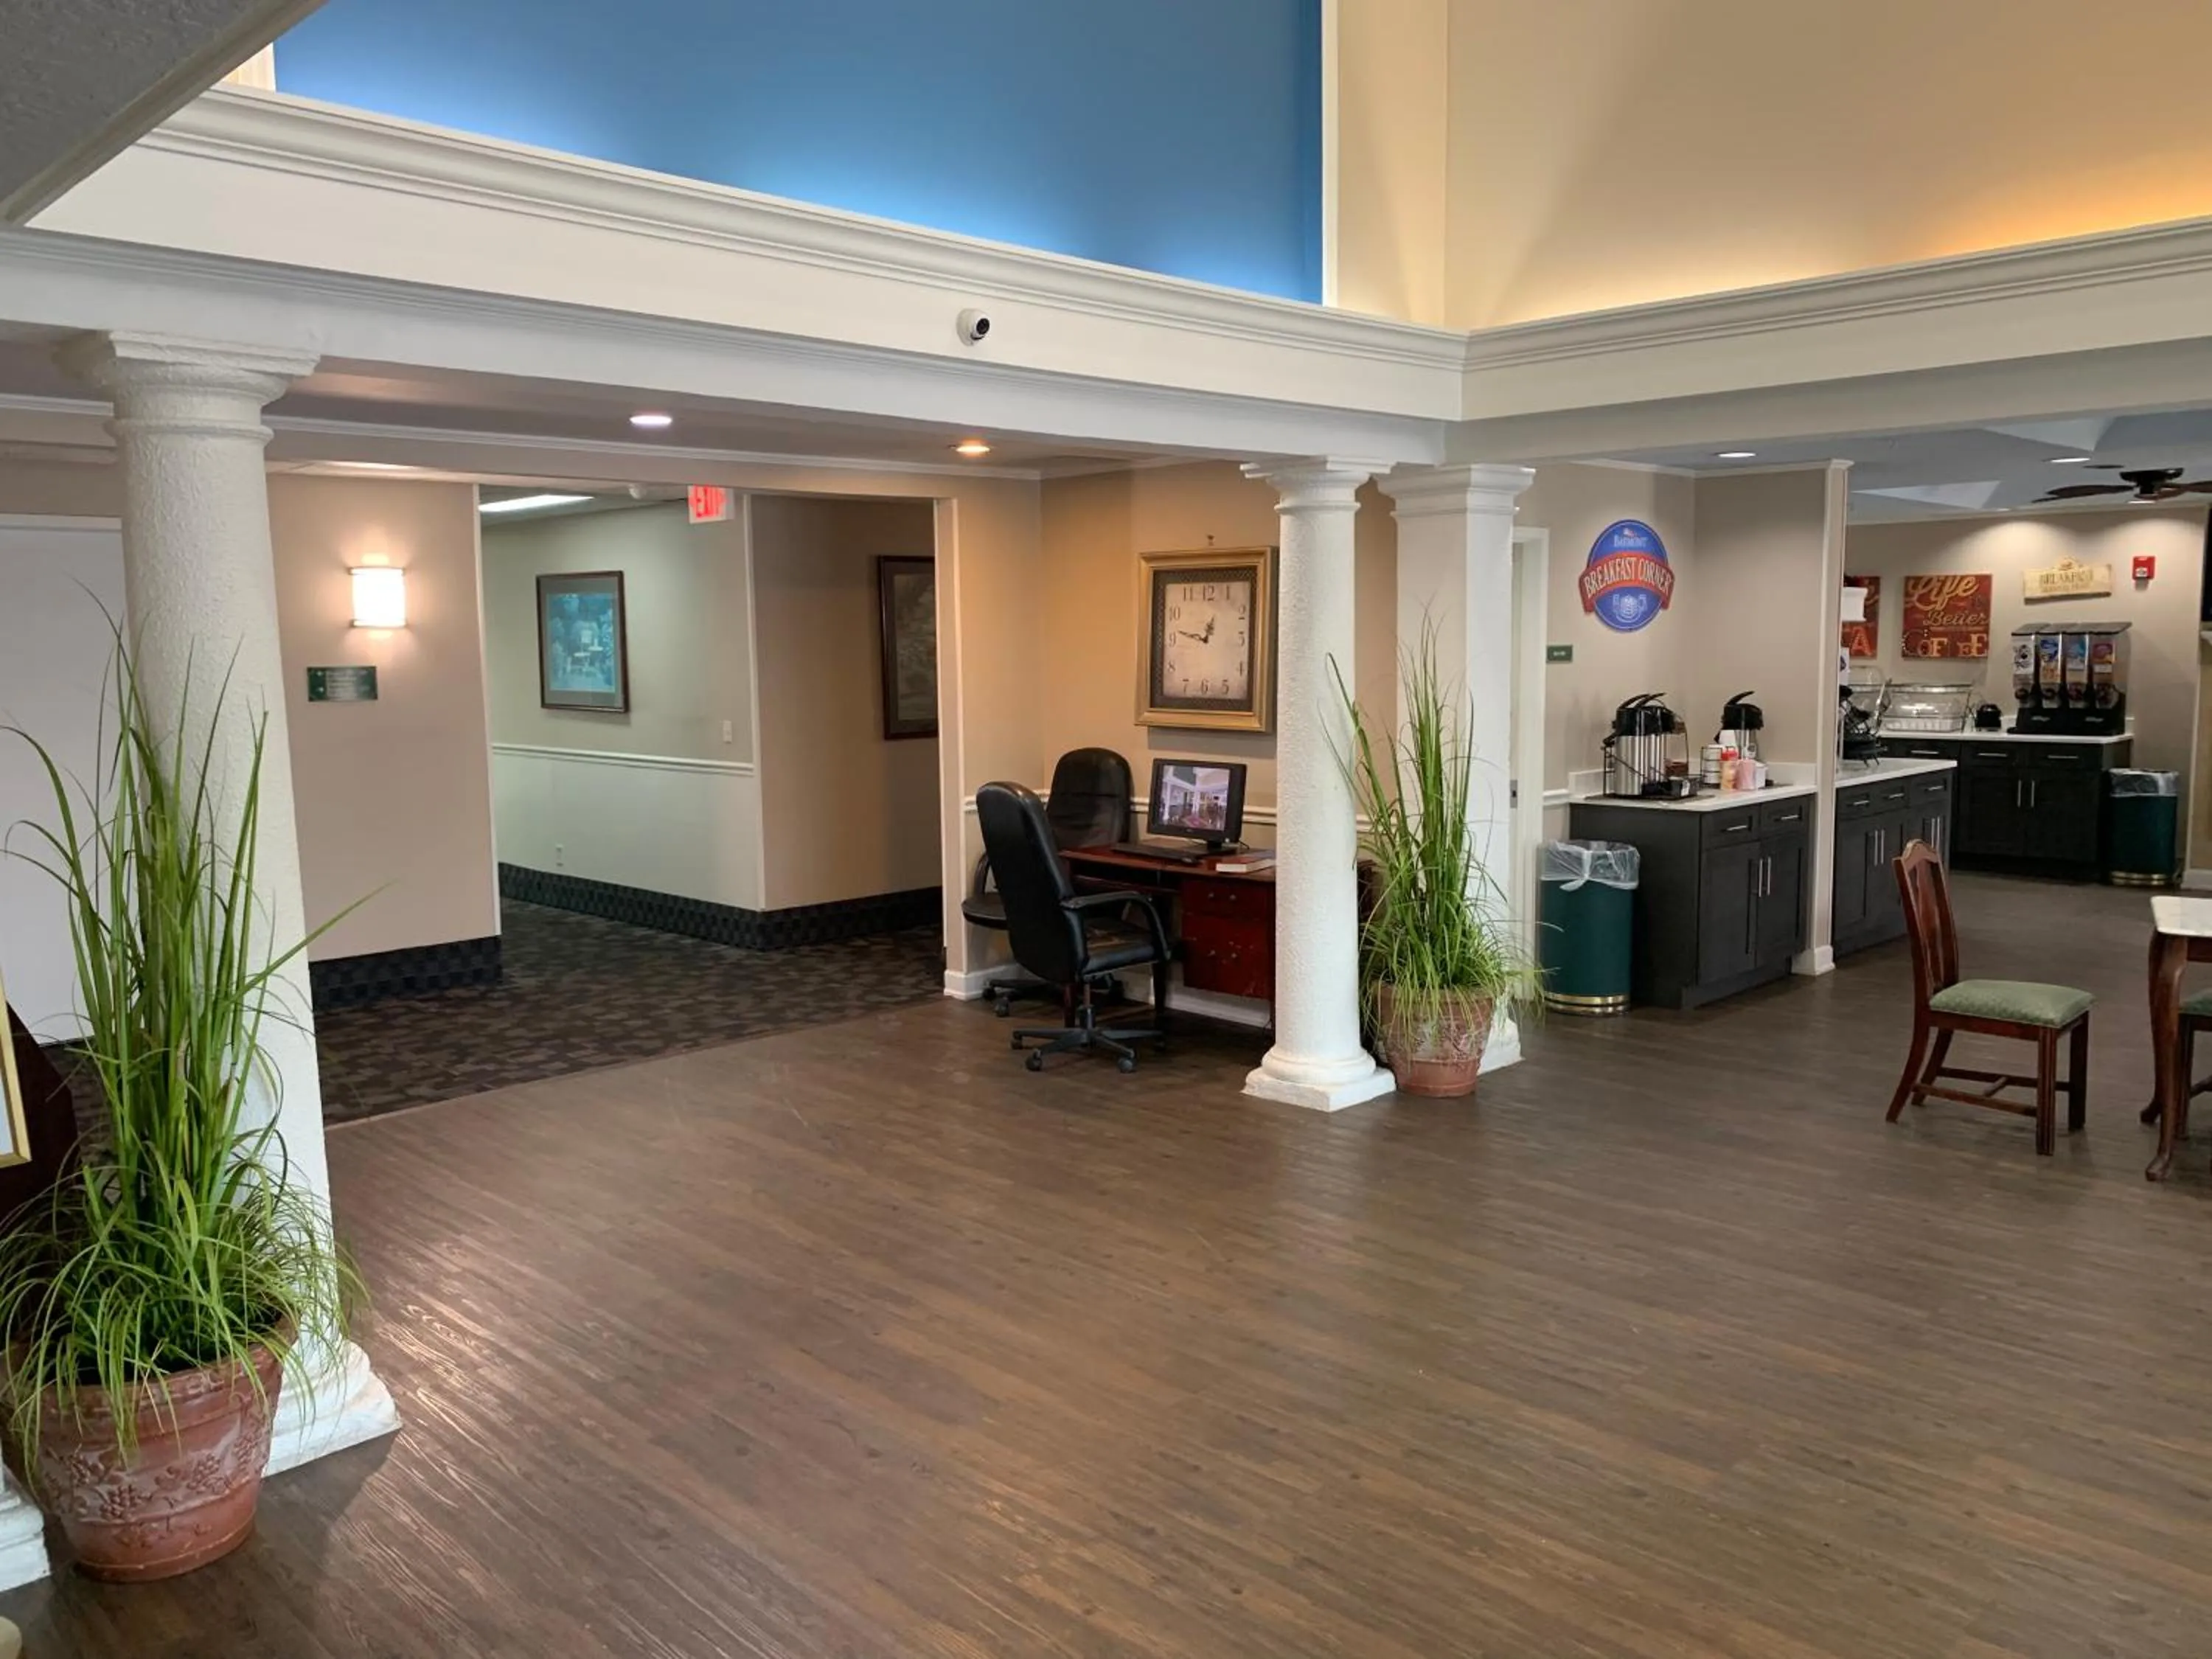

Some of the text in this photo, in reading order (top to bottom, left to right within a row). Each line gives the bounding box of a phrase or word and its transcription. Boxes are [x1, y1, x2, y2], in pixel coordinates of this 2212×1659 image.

[1584, 557, 1671, 599] BREAKFAST CORNER
[1183, 586, 1194, 601] 11
[1203, 585, 1215, 602] 12
[1169, 606, 1180, 621] 10
[1238, 605, 1246, 620] 2
[1169, 632, 1177, 647] 9
[1238, 630, 1245, 647] 3
[1902, 631, 1988, 658] COFEE
[1167, 659, 1176, 675] 8
[1236, 661, 1245, 676] 4
[1182, 678, 1189, 695] 7
[1200, 679, 1209, 695] 6
[1221, 679, 1230, 695] 5
